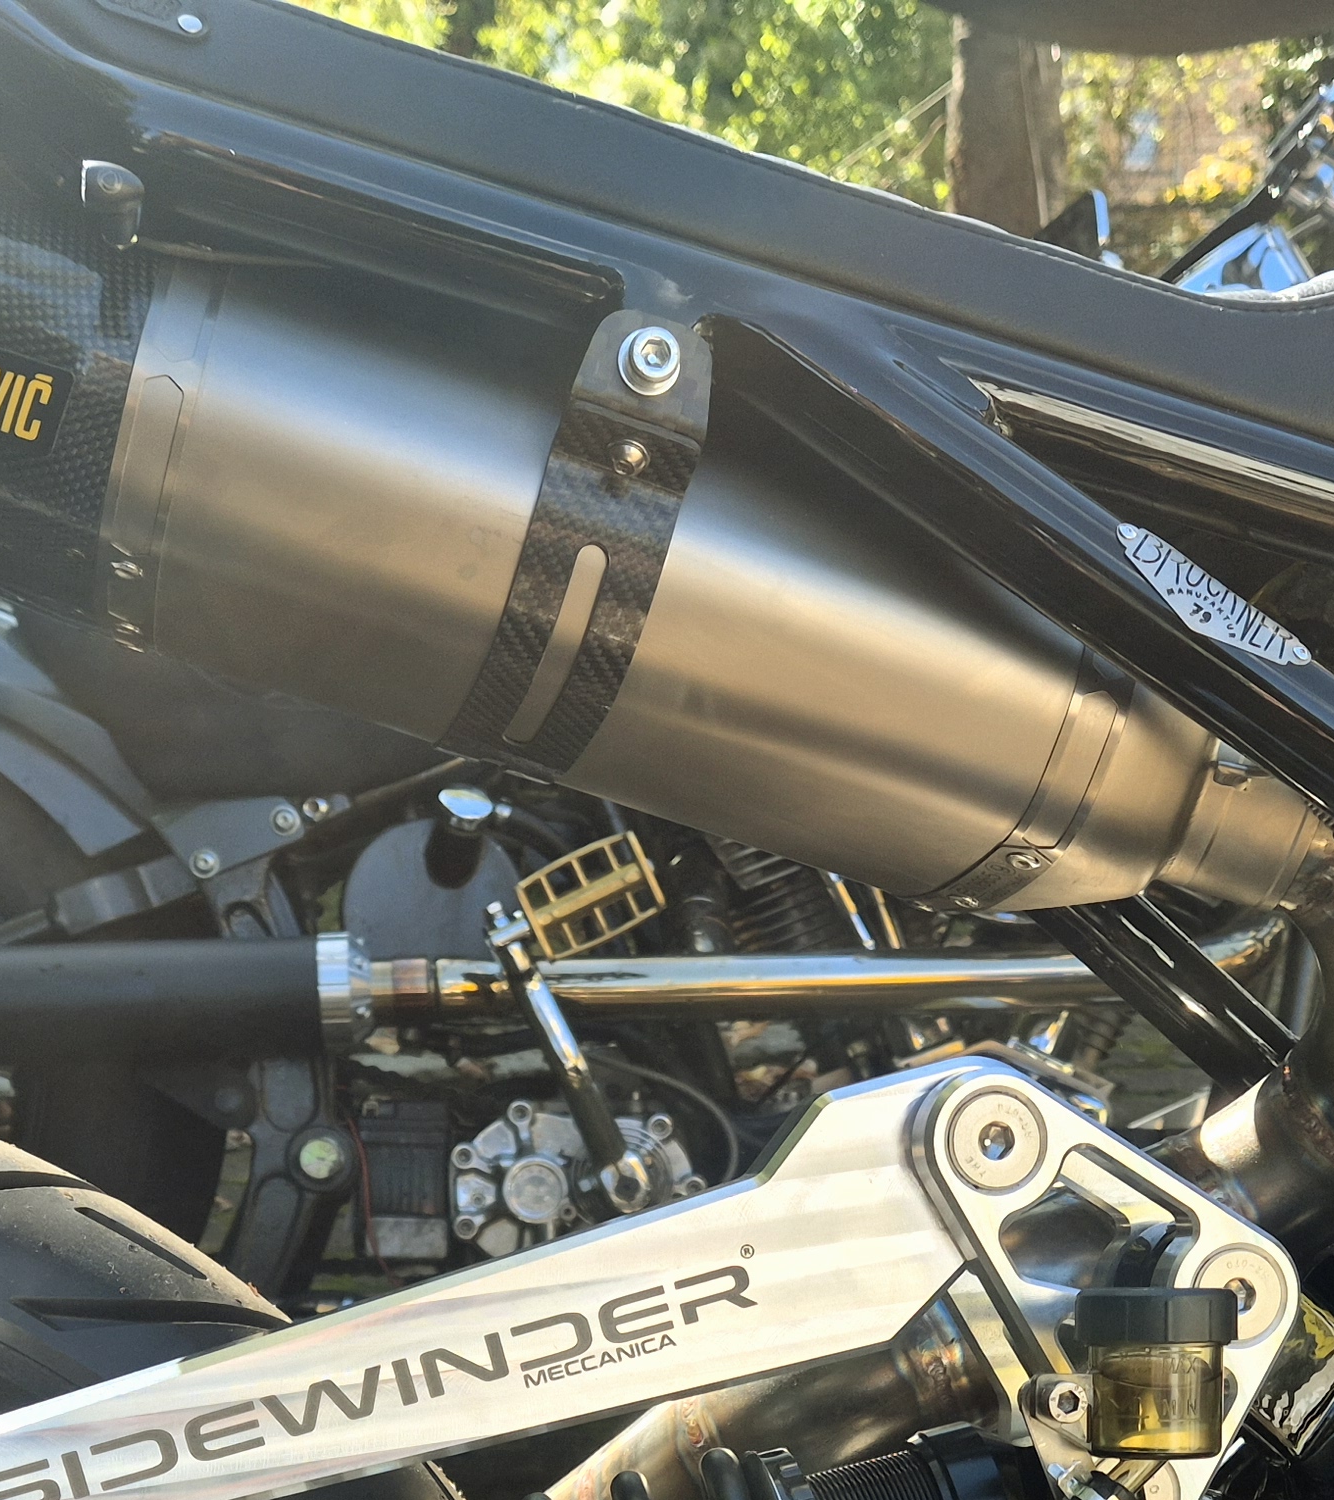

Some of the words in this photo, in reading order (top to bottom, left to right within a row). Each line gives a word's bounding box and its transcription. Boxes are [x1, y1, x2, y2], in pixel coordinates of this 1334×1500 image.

[1189, 602, 1212, 624] 79
[523, 1333, 677, 1389] MECCANICA
[1162, 1398, 1197, 1416] MN
